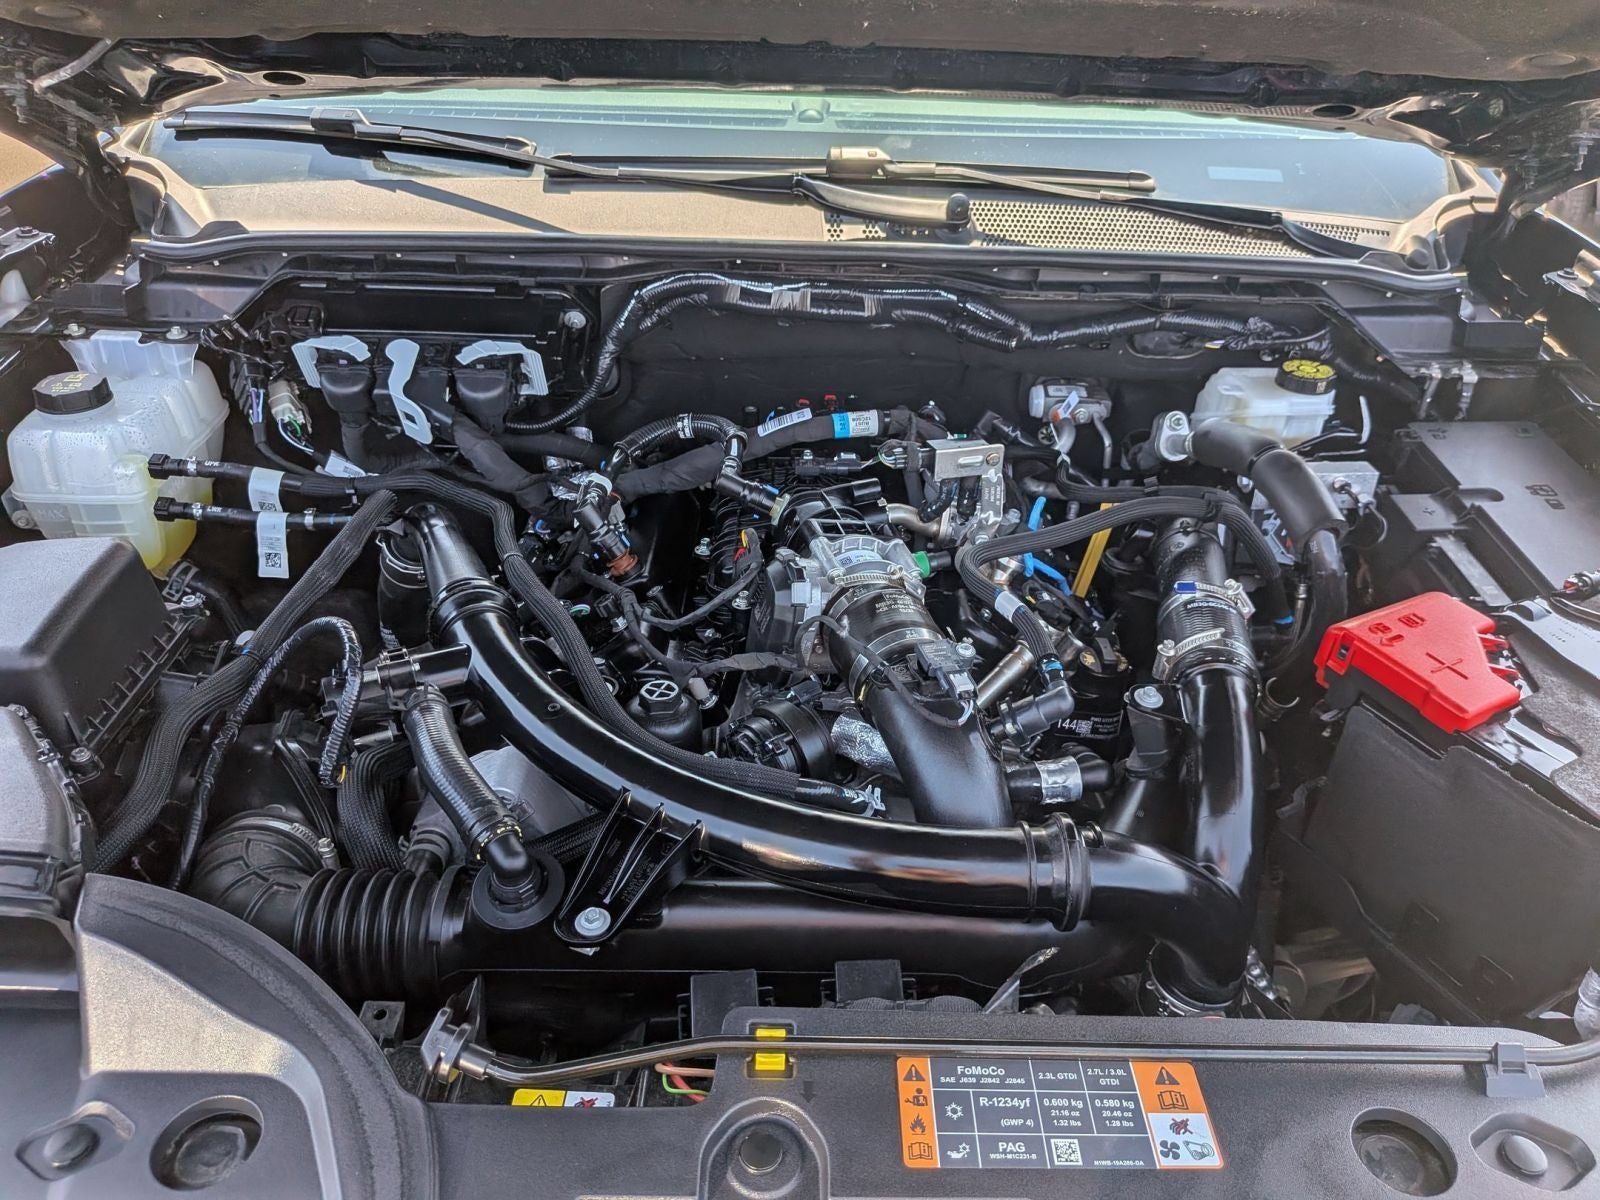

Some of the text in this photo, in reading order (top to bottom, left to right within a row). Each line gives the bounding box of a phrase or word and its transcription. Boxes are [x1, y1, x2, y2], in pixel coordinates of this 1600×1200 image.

[956, 1065, 1006, 1076] FoMoCo
[1087, 1068, 1104, 1076] 2.7L
[1109, 1068, 1127, 1076] 3.0L
[1038, 1072, 1056, 1080] 2.3L
[1100, 1078, 1120, 1086] GTDI
[979, 1096, 1031, 1109] R-1234yf
[1043, 1098, 1083, 1109] 0.600 kg
[1094, 1099, 1135, 1109] 0.580 kg
[1000, 1118, 1034, 1128] (GWP 4)
[1070, 1119, 1082, 1127] lbs
[998, 1142, 1026, 1153] PAG
